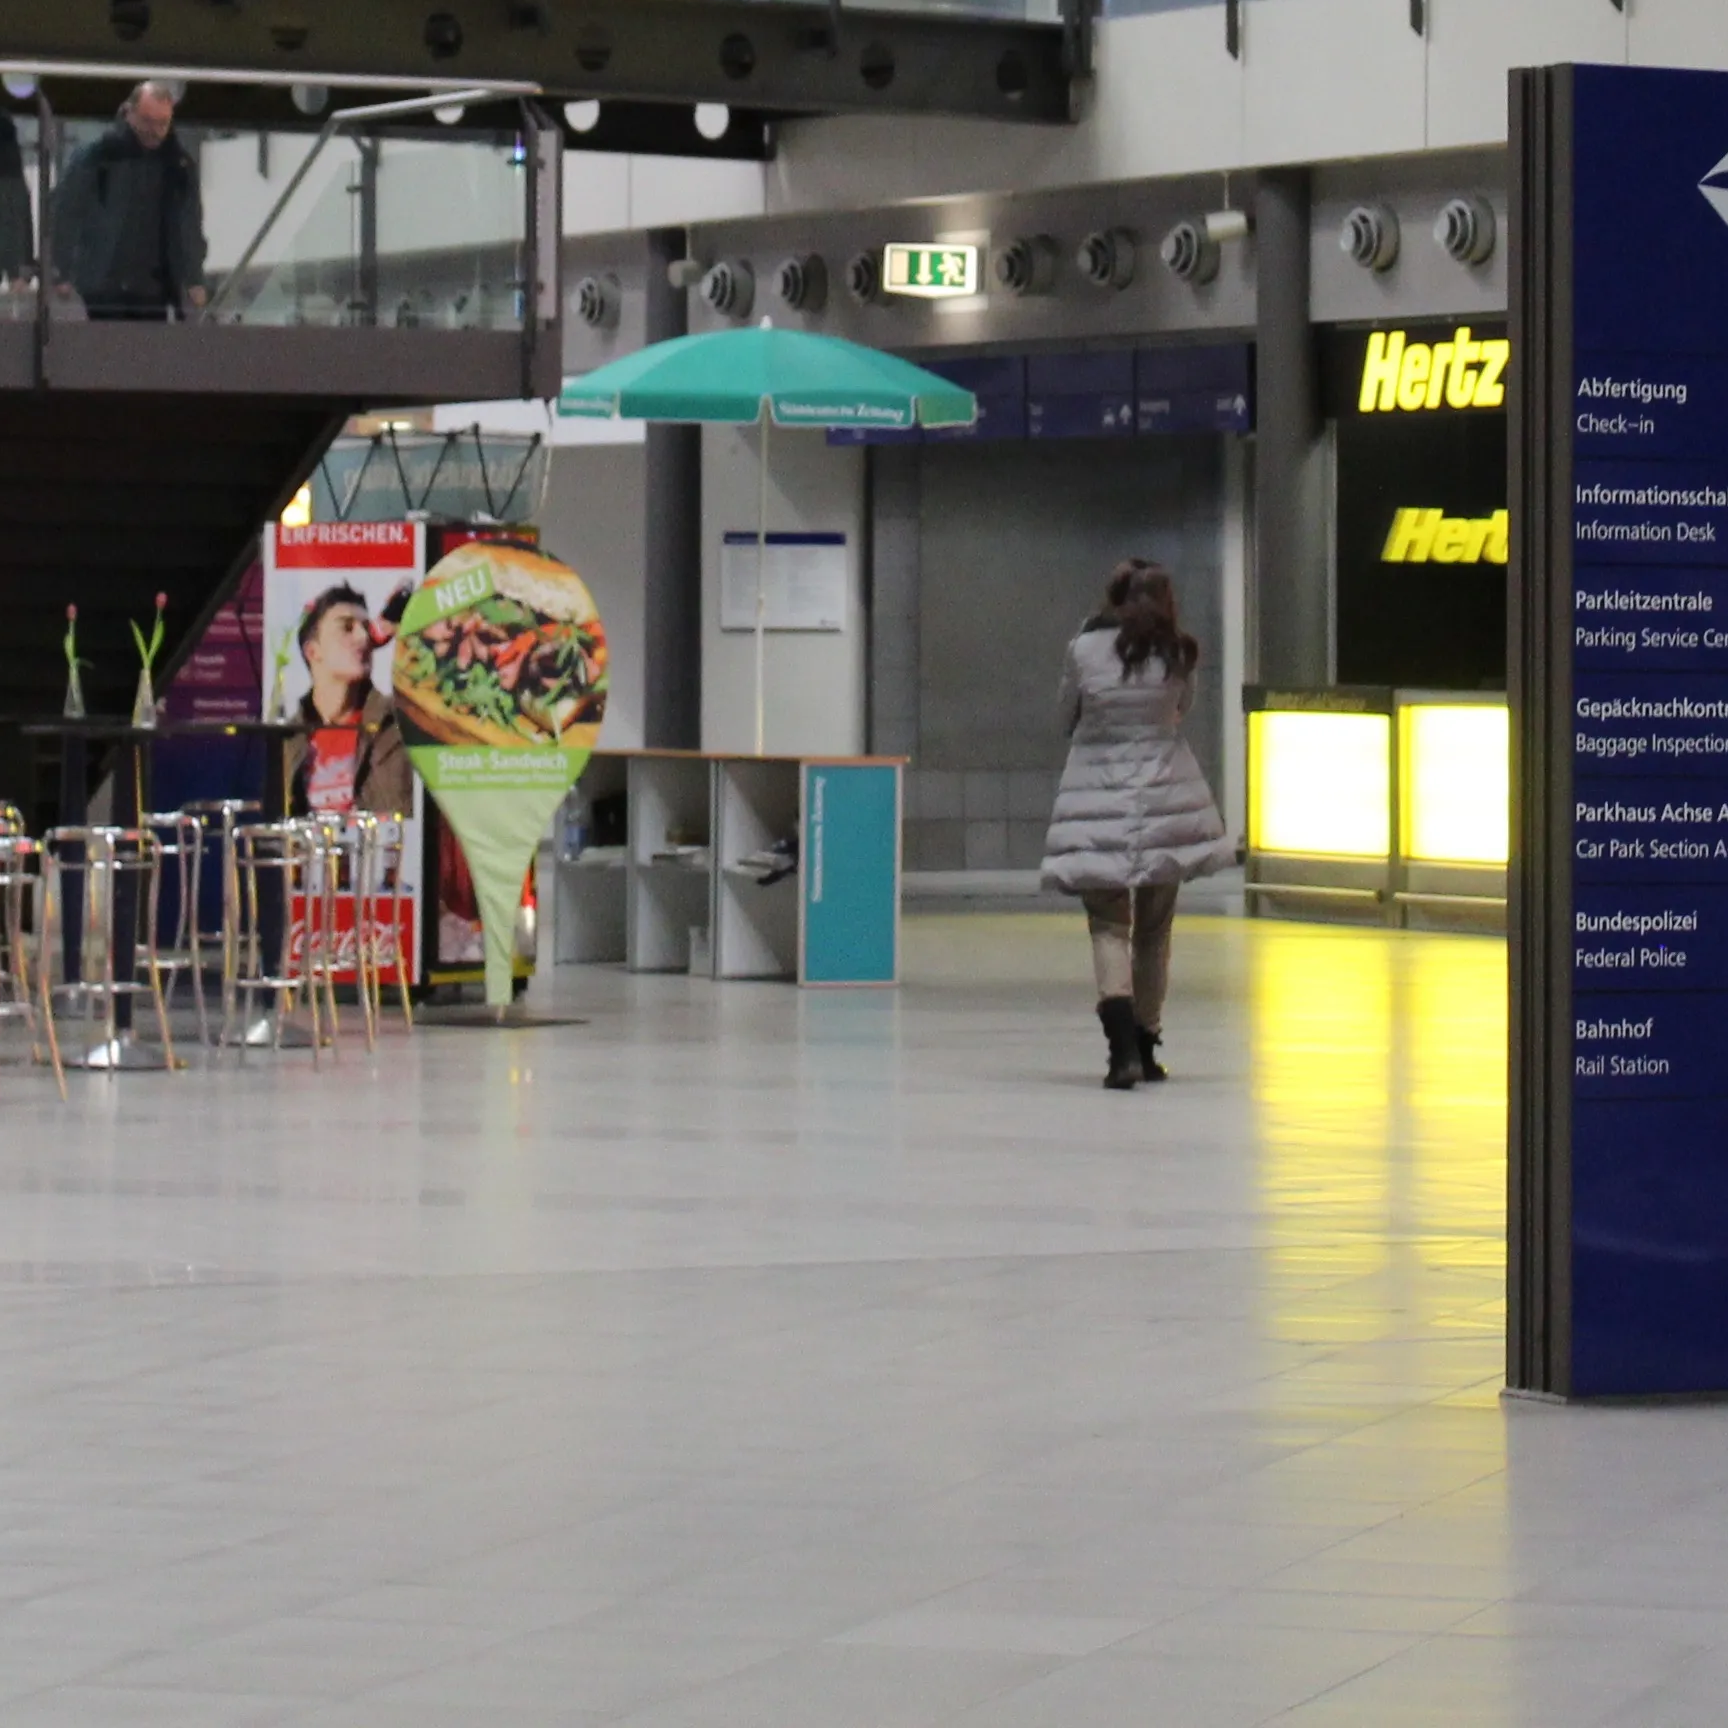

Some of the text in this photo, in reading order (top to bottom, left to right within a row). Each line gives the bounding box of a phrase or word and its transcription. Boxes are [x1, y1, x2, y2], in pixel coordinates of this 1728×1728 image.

[1358, 326, 1510, 413] Hertz
[1577, 377, 1688, 404] Abfertigung
[1577, 413, 1655, 434] Check-in
[281, 523, 409, 545] ERFRISCHEN.
[1381, 507, 1509, 564] Hert
[1576, 522, 1716, 542] Information Desk
[434, 569, 488, 613] NEU
[1576, 590, 1713, 612] Parkleitzentrale
[1576, 627, 1636, 652] Parking
[1641, 627, 1699, 648] Service
[1576, 735, 1647, 758] Baggage
[1576, 802, 1656, 823] Parkhaus
[1661, 803, 1712, 823] Achse
[1576, 840, 1605, 858] Car
[1610, 840, 1645, 858] Park
[1650, 840, 1709, 858] Section
[1576, 910, 1698, 935] Bundespolizei
[1576, 948, 1687, 967] Federal Police
[1576, 1017, 1653, 1039] Bahnhof
[1576, 1056, 1670, 1074] Rail Station
